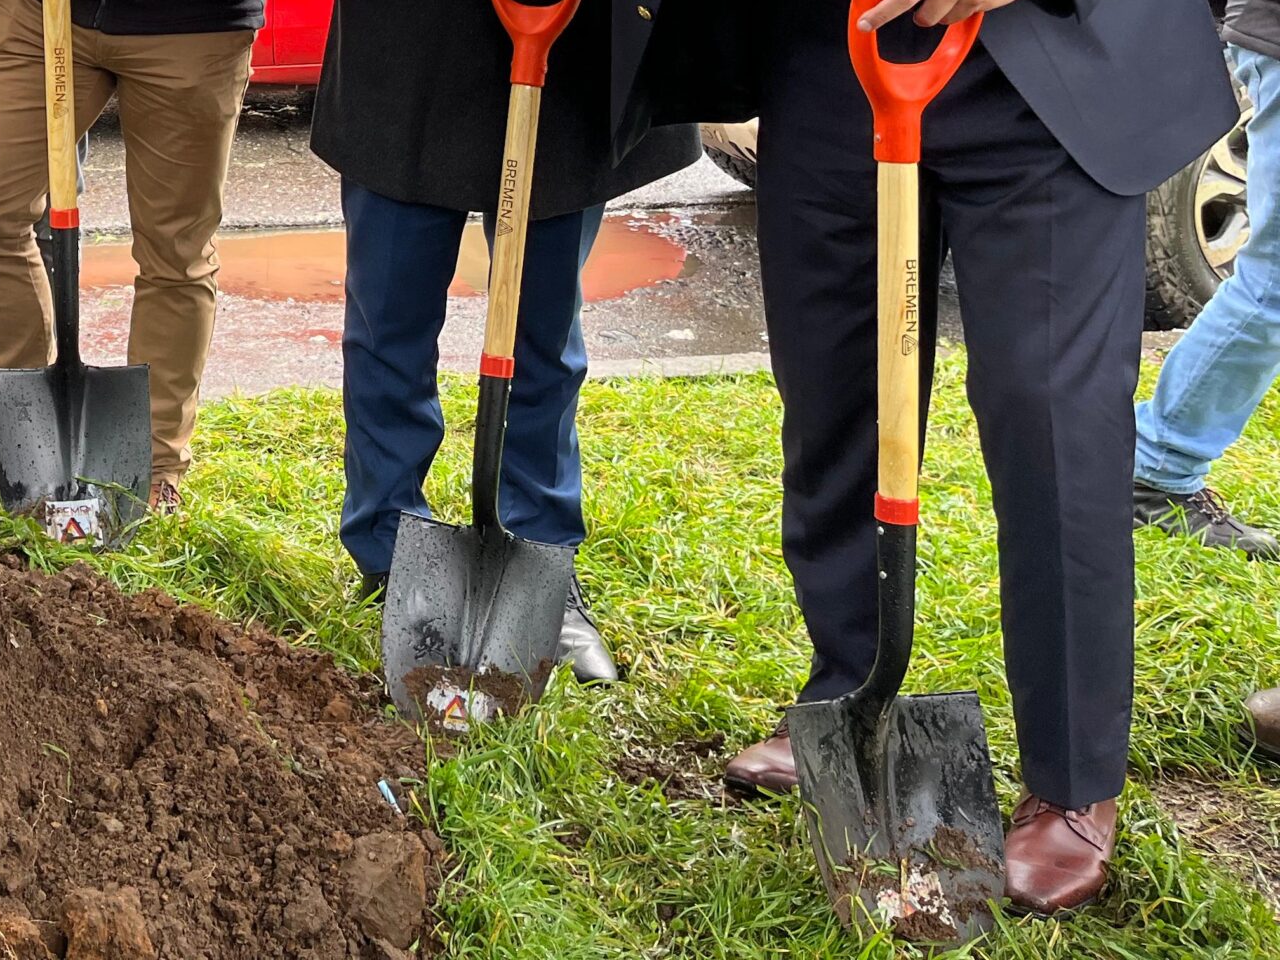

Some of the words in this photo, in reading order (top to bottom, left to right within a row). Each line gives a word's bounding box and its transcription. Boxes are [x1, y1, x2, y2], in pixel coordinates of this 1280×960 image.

[53, 47, 67, 102] BREMEN
[501, 158, 518, 219] BREMEN
[905, 259, 917, 332] BREMEN
